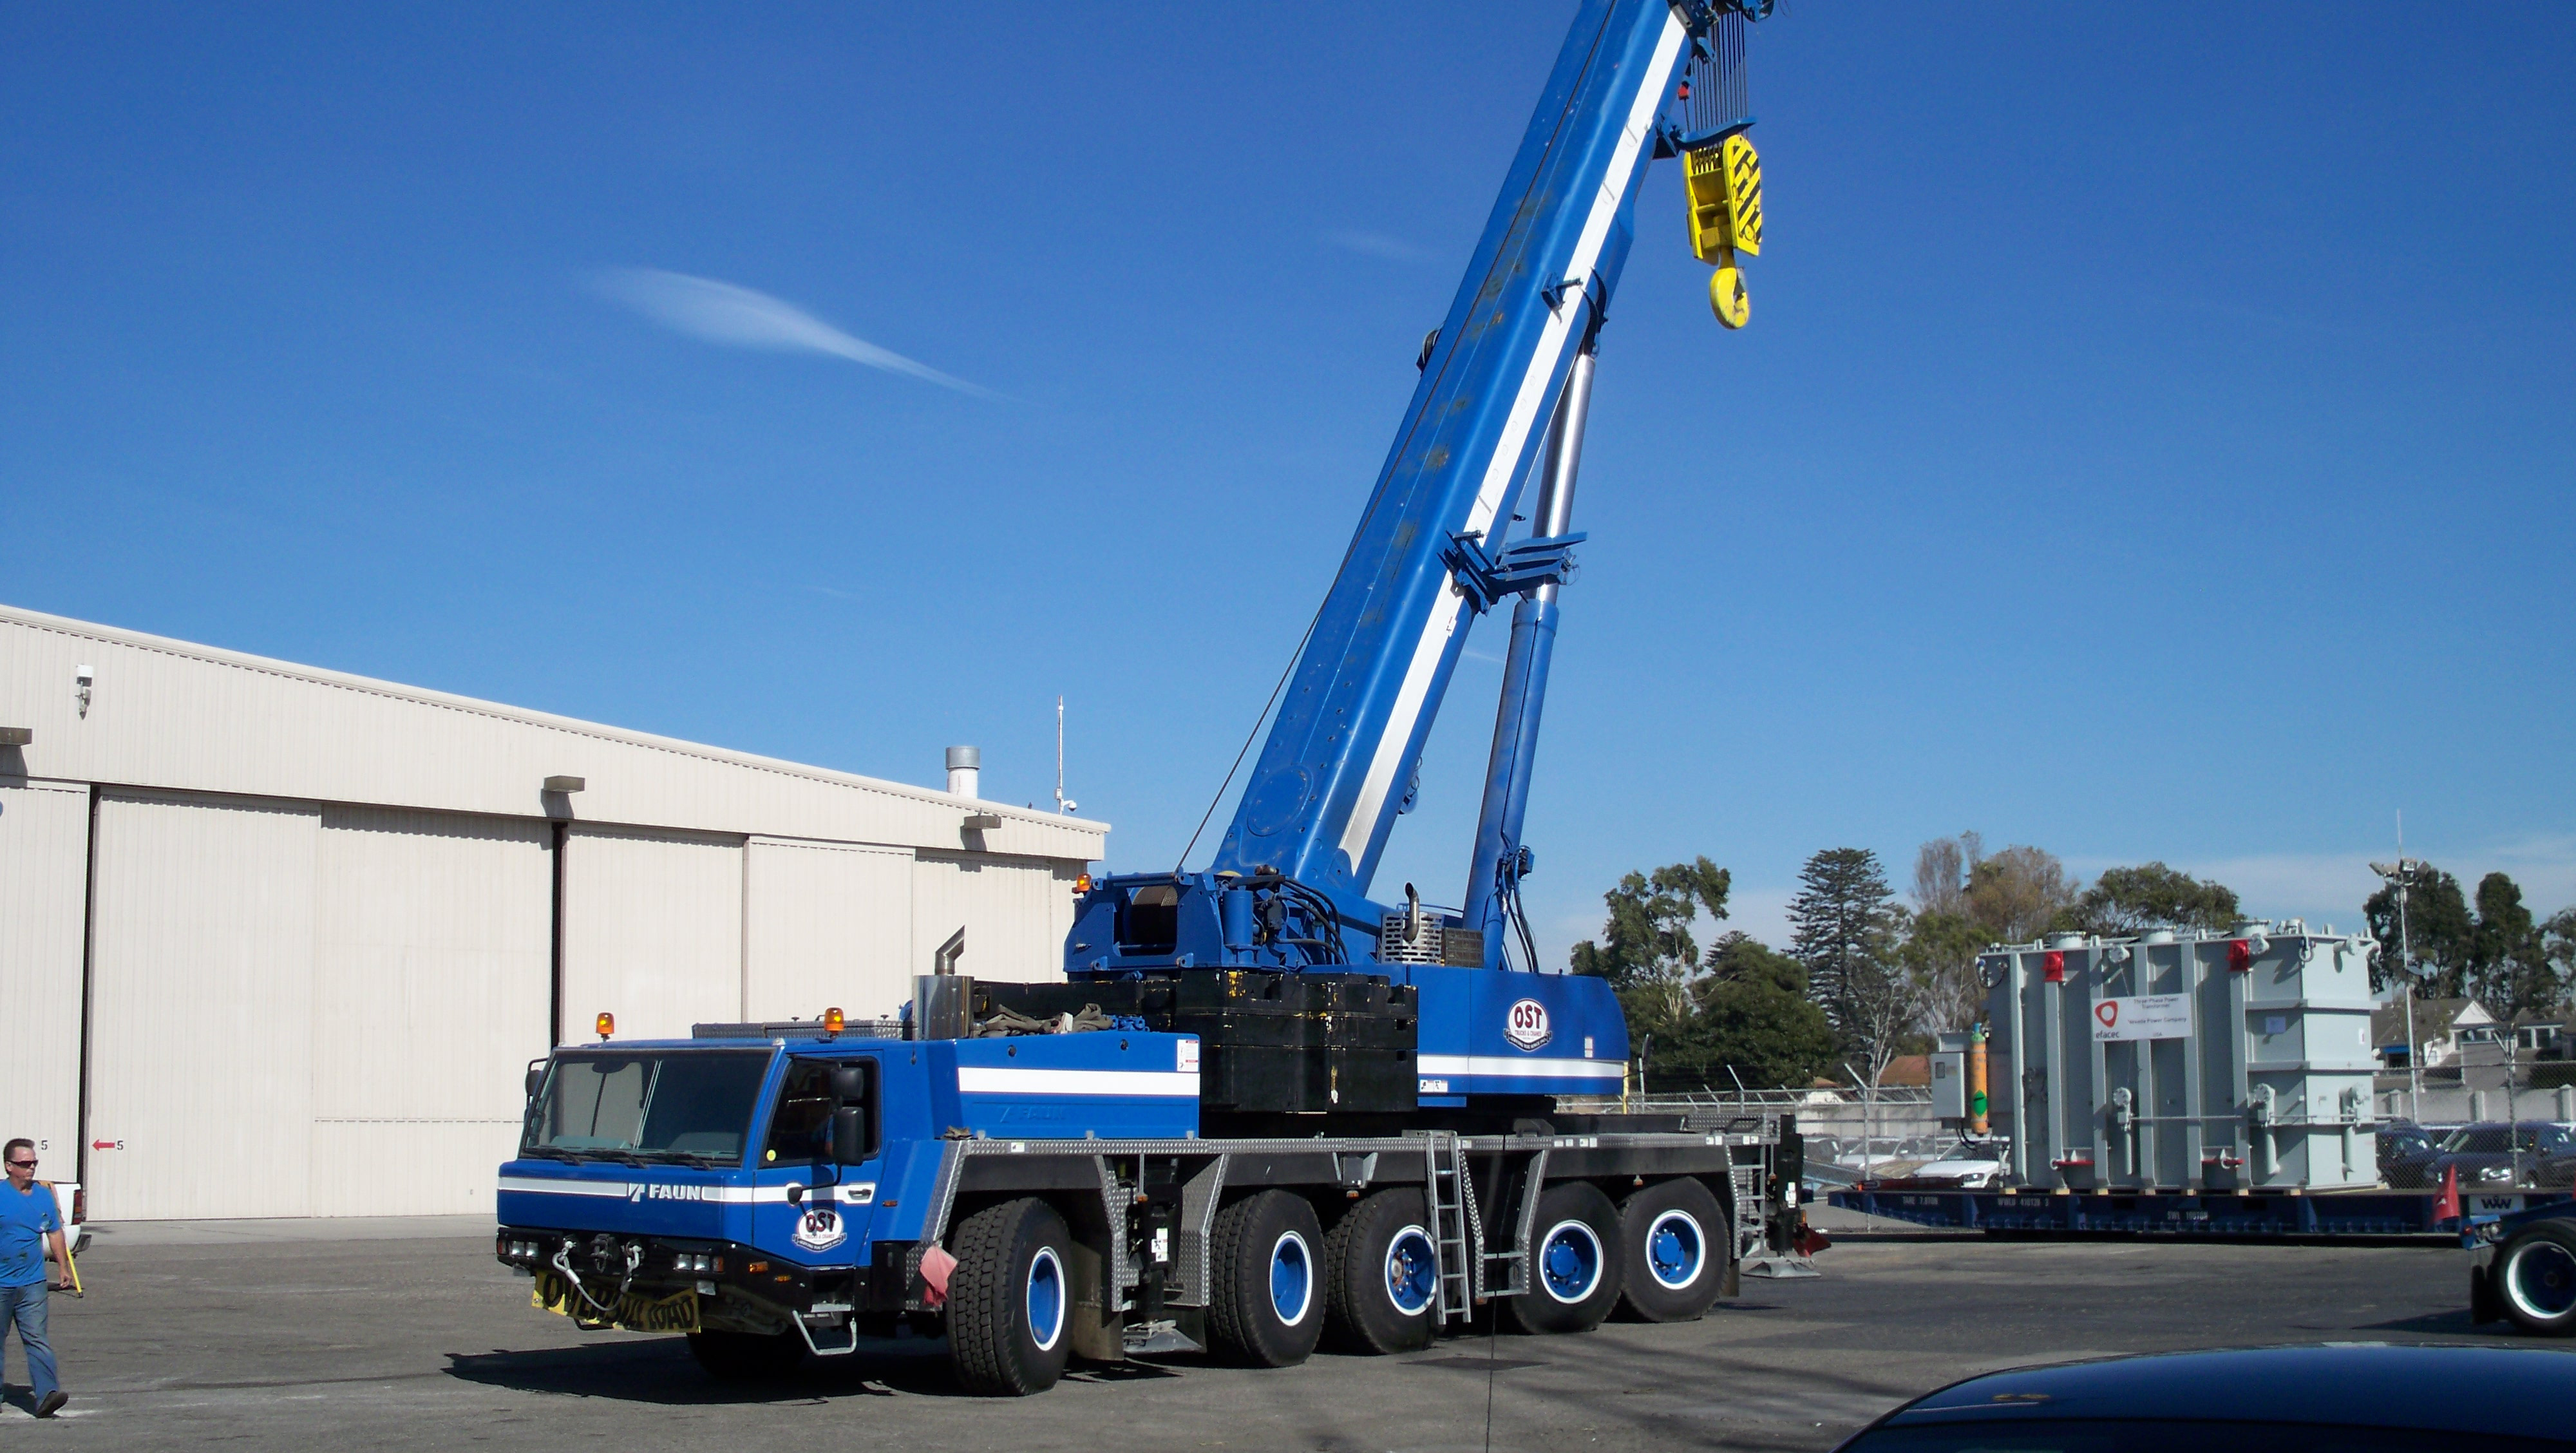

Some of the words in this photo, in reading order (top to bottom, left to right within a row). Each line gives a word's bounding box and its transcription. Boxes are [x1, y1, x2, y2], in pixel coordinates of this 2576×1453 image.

[1514, 1004, 1542, 1029] OST
[2095, 1030, 2120, 1038] efacec
[41, 1139, 48, 1150] 5
[117, 1140, 124, 1150] 5
[649, 1184, 701, 1200] FAUN
[806, 1211, 836, 1233] OST
[648, 1295, 695, 1329] LOAD
